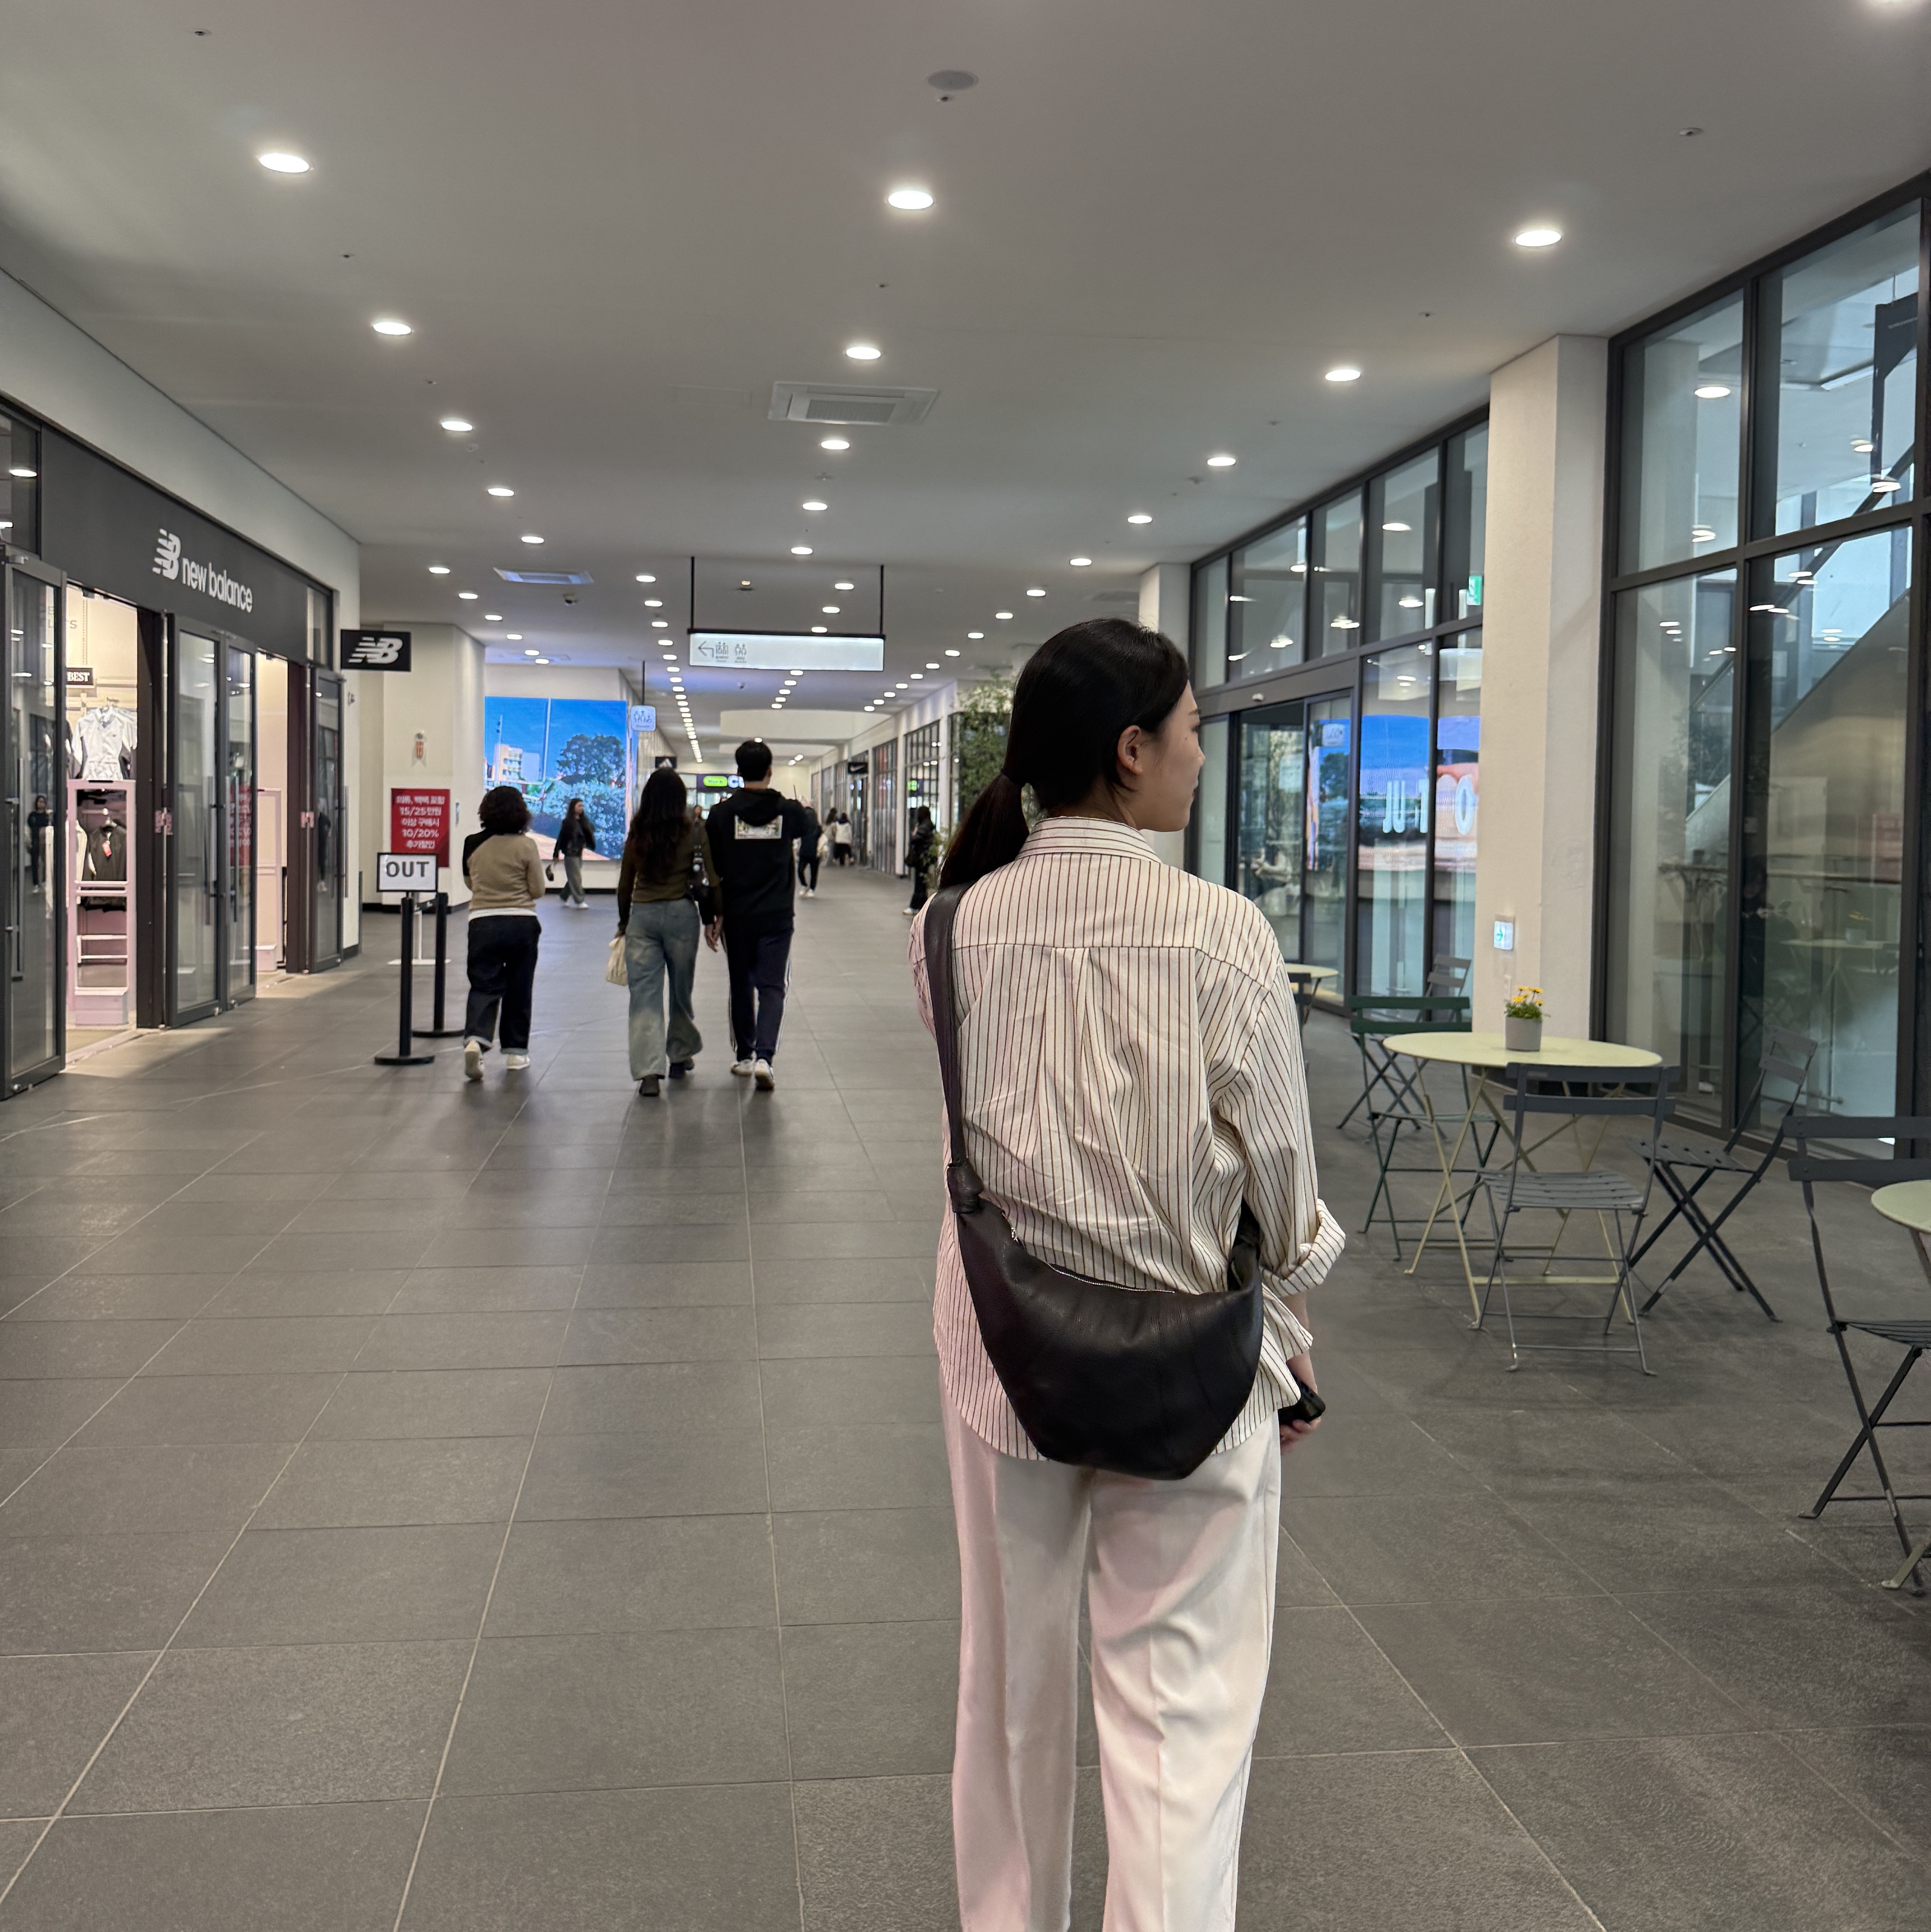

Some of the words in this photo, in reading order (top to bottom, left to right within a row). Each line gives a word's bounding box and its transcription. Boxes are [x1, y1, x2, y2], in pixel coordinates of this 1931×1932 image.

[183, 557, 207, 593] new
[209, 561, 252, 613] balance
[67, 671, 90, 682] BEST
[402, 828, 439, 839] 10/20%
[386, 861, 430, 877] OUT
